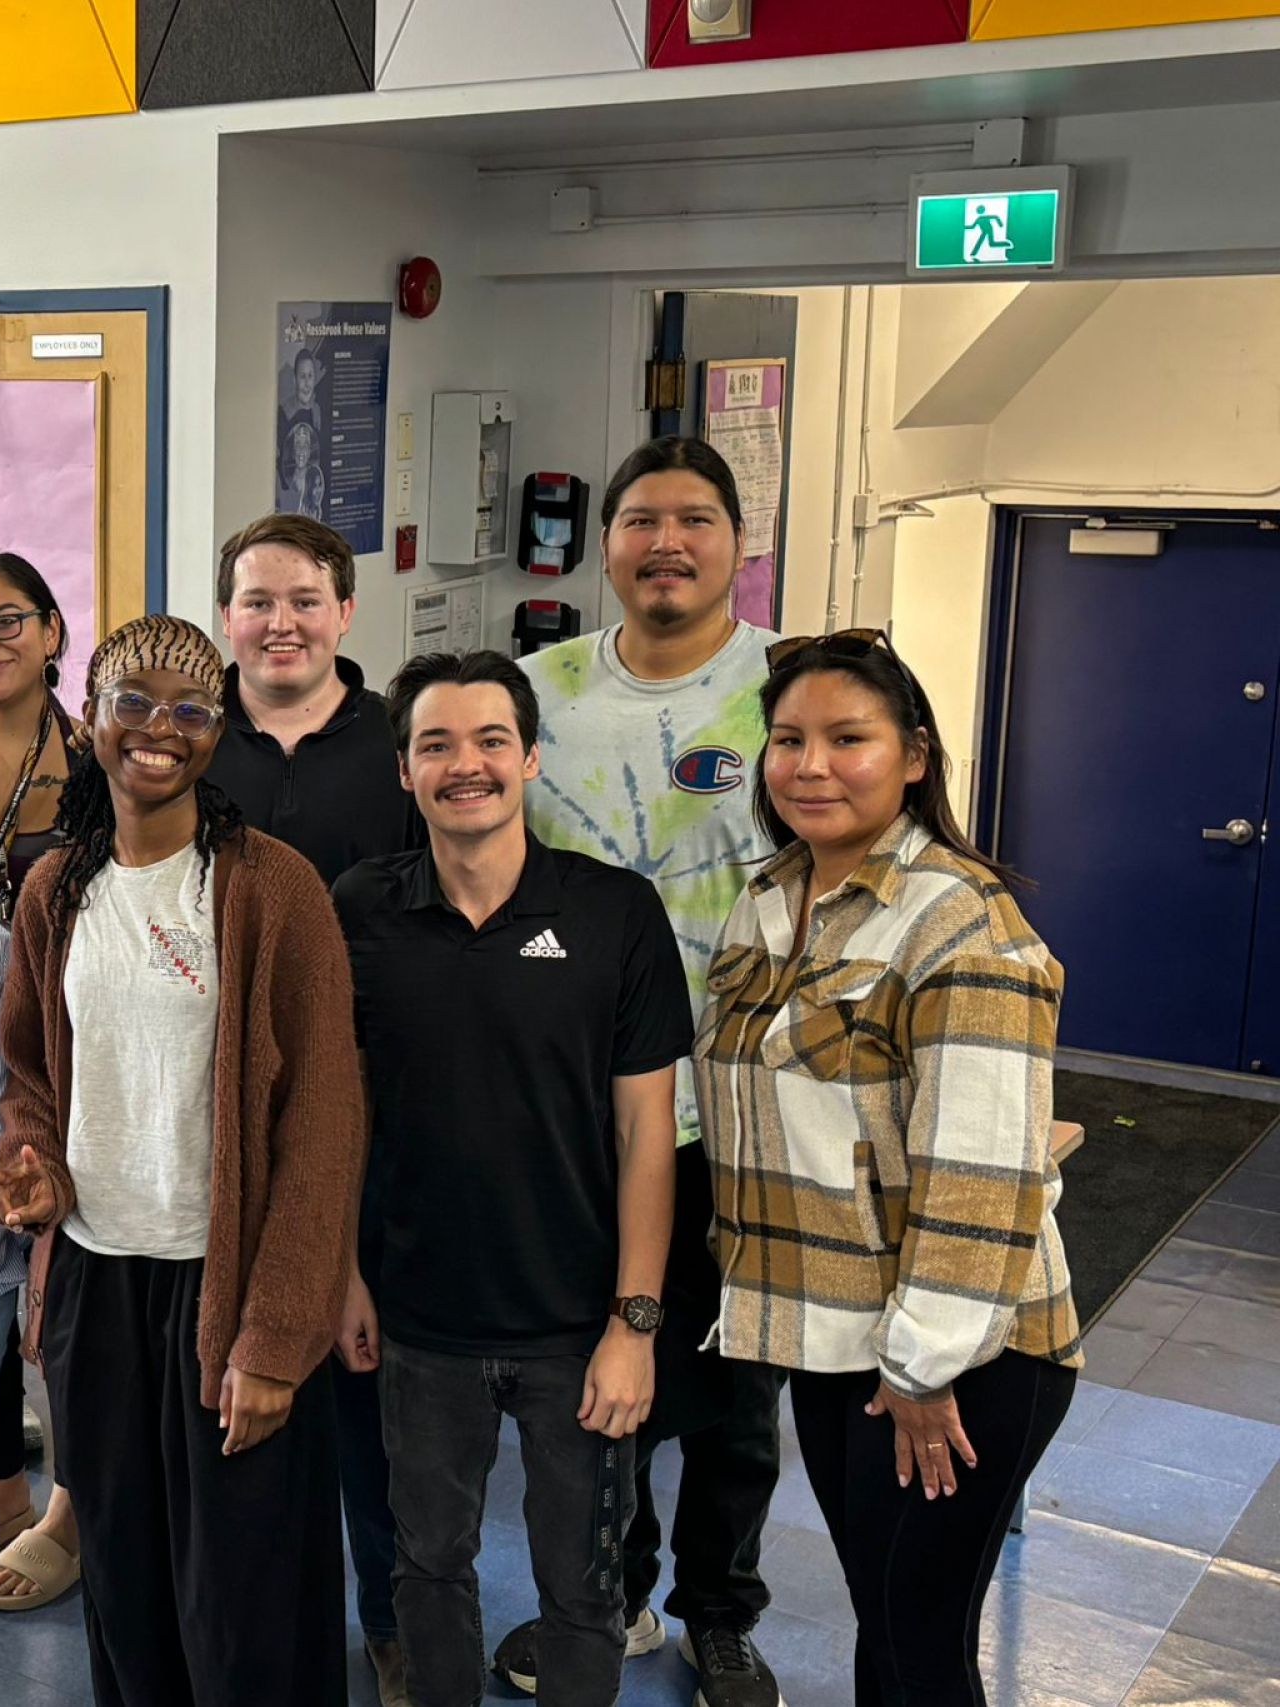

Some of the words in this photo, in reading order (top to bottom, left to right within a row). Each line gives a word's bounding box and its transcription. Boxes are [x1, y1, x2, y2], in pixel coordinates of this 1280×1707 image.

[35, 341, 77, 350] EMPLOYEES
[79, 341, 99, 350] ONLY
[519, 947, 567, 959] adidas
